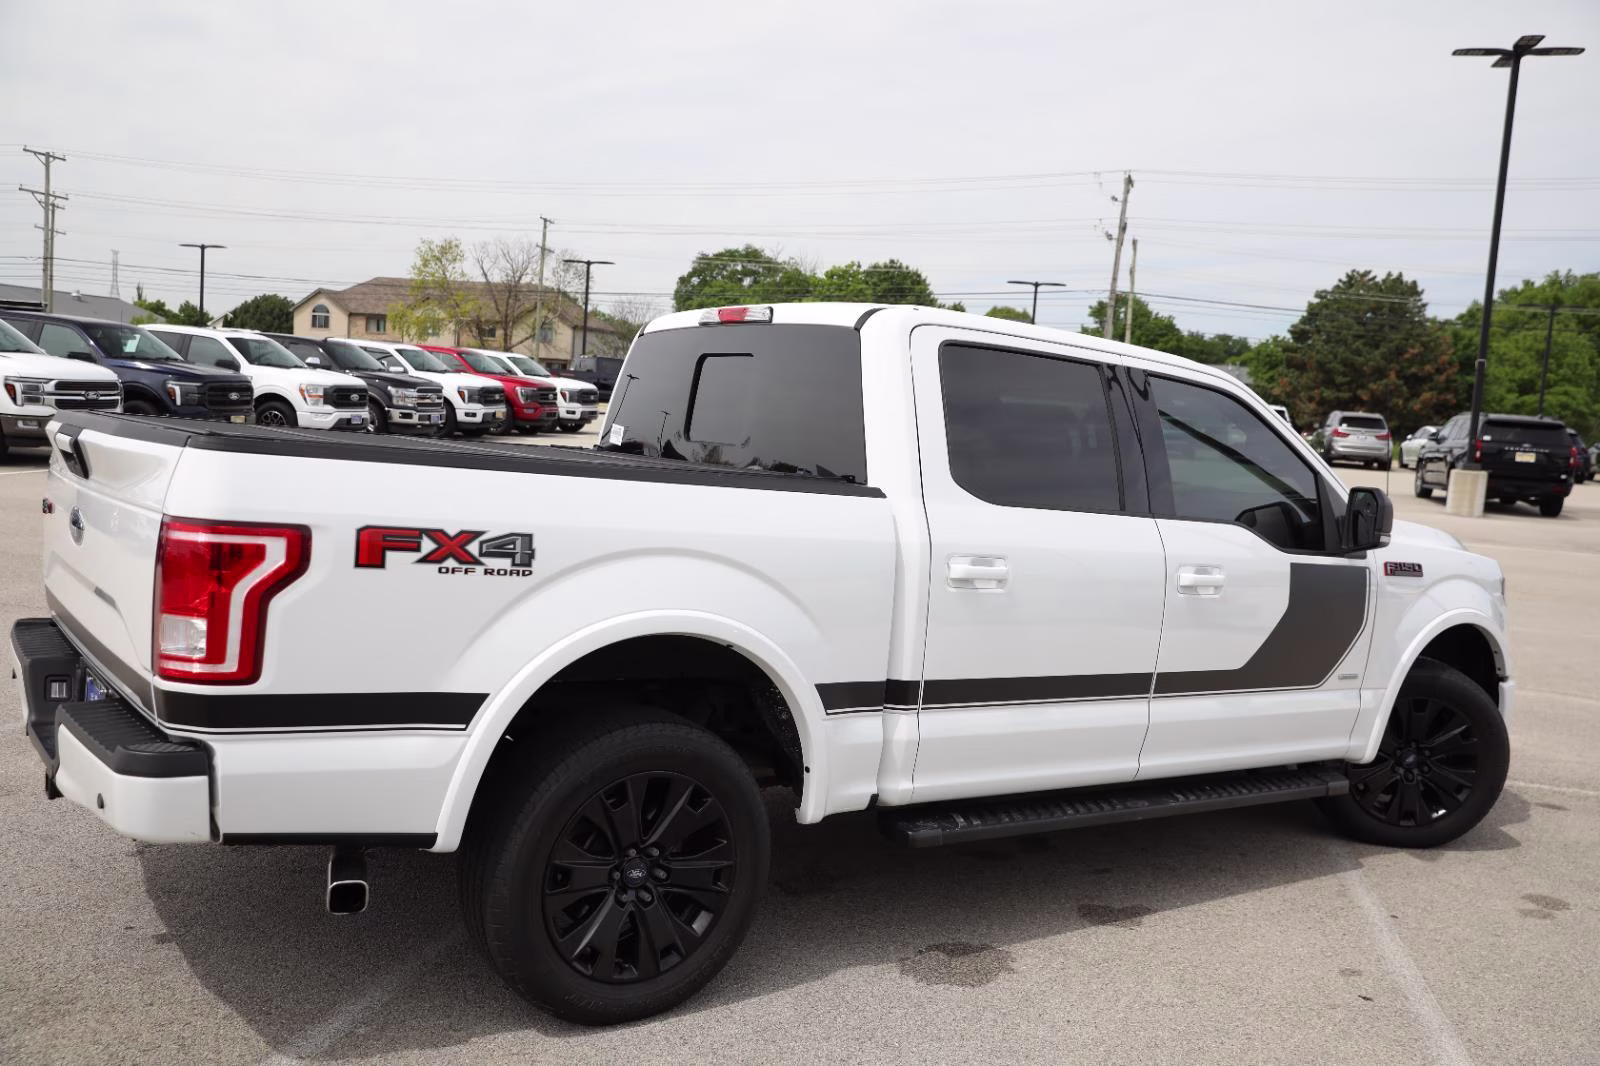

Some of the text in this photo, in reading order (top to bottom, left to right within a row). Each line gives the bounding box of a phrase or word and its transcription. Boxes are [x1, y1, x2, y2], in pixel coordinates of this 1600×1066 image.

[354, 525, 535, 568] FX4
[438, 566, 533, 577] OFF ROAD
